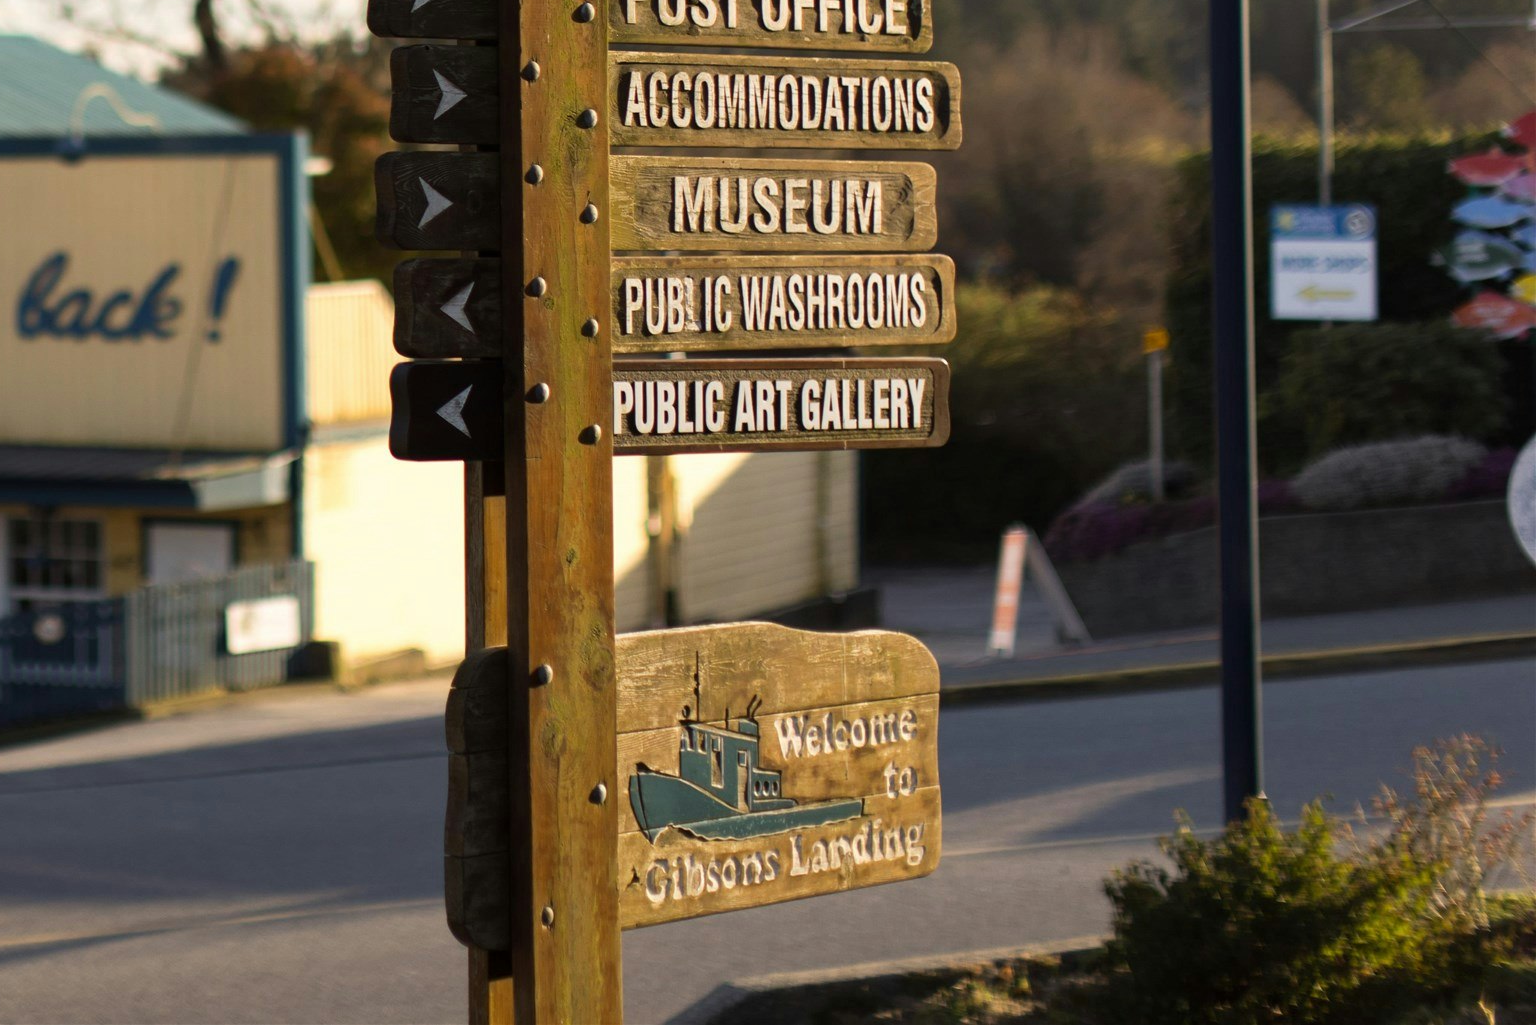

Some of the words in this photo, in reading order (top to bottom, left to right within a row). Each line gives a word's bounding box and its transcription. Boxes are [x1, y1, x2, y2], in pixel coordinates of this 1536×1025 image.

[623, 70, 935, 134] ACCOMMODATIONS
[673, 176, 883, 236] MUSEUM
[624, 274, 733, 336] PUBLIC
[739, 271, 927, 333] WASHROOMS
[612, 379, 726, 436] PUBLIC
[734, 378, 793, 433] ART
[801, 377, 926, 431] GALLERY
[772, 708, 919, 761] Welcome
[883, 760, 919, 799] to
[644, 846, 781, 905] Gibsons
[789, 817, 926, 876] Landing
